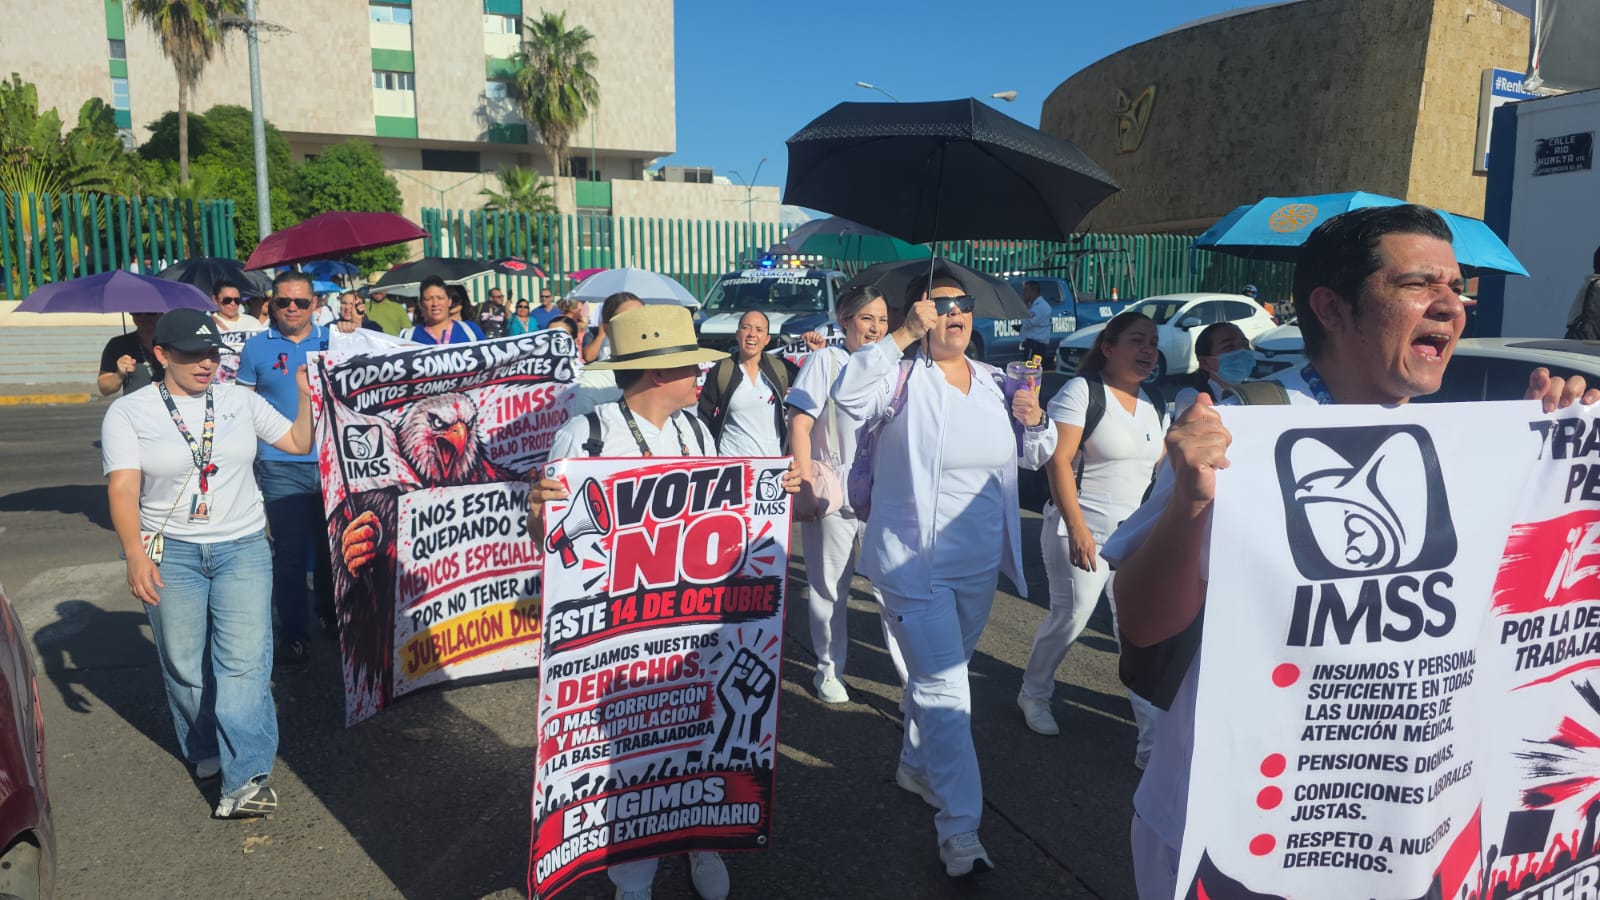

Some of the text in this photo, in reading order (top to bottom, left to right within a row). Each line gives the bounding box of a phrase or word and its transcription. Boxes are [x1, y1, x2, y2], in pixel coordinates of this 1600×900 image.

[1549, 135, 1576, 146] CALLE
[1554, 145, 1569, 154] RIO
[336, 333, 549, 397] TODOS SOMOS IMSS
[354, 357, 551, 412] JUNTOS SOMOS MÁS FUERTES
[487, 408, 568, 445] TRABAJANDO
[490, 431, 556, 460] BAJO PROTE
[347, 457, 390, 479] IMSS
[614, 464, 744, 528] VOTA
[754, 502, 786, 516] IMSS
[411, 499, 456, 538] ¡NOS
[412, 515, 511, 560] QUEDANDO
[611, 513, 744, 594] NO
[400, 551, 460, 604] MÉDICOS
[411, 601, 444, 632] POR
[447, 594, 467, 616] NO
[471, 578, 520, 605] TENER
[549, 584, 776, 644] ESTE 14 DE OCTUBRE
[1286, 571, 1457, 647] IMSS
[1500, 606, 1600, 645] POR LA DE
[407, 604, 542, 673] JUBILACIÓN DIG
[547, 632, 719, 682] PROTEJAMOS NUESTROS
[1515, 631, 1600, 672] TRABAJA
[556, 651, 706, 709] DERECHOS,
[1308, 669, 1474, 700] SUFICIENTE EN TODAS
[1312, 648, 1476, 680] INSUMOS Y PERSONAL
[544, 684, 708, 743] NO MAS CORRUPCIÓN
[556, 703, 700, 751] Y MANIPULACIÓN
[1301, 716, 1454, 742] ATENCIÓN MÉDICA.
[1305, 697, 1453, 721] LAS UNIDADES DE
[552, 754, 568, 772] LA
[571, 743, 611, 764] BASE
[614, 720, 715, 756] TRABAJADORA
[1297, 744, 1454, 774] PENSIONES DIGNAS.
[1294, 760, 1473, 804] CONDICIONES LABORALES
[563, 777, 725, 839] EXIGIMOS
[1290, 803, 1367, 822] JUSTAS.
[536, 803, 760, 884] CONGRESO EXTRAORDINARIO
[1286, 817, 1451, 856] RESPETO A NUESTROS
[1283, 850, 1393, 874] DERECHOS.
